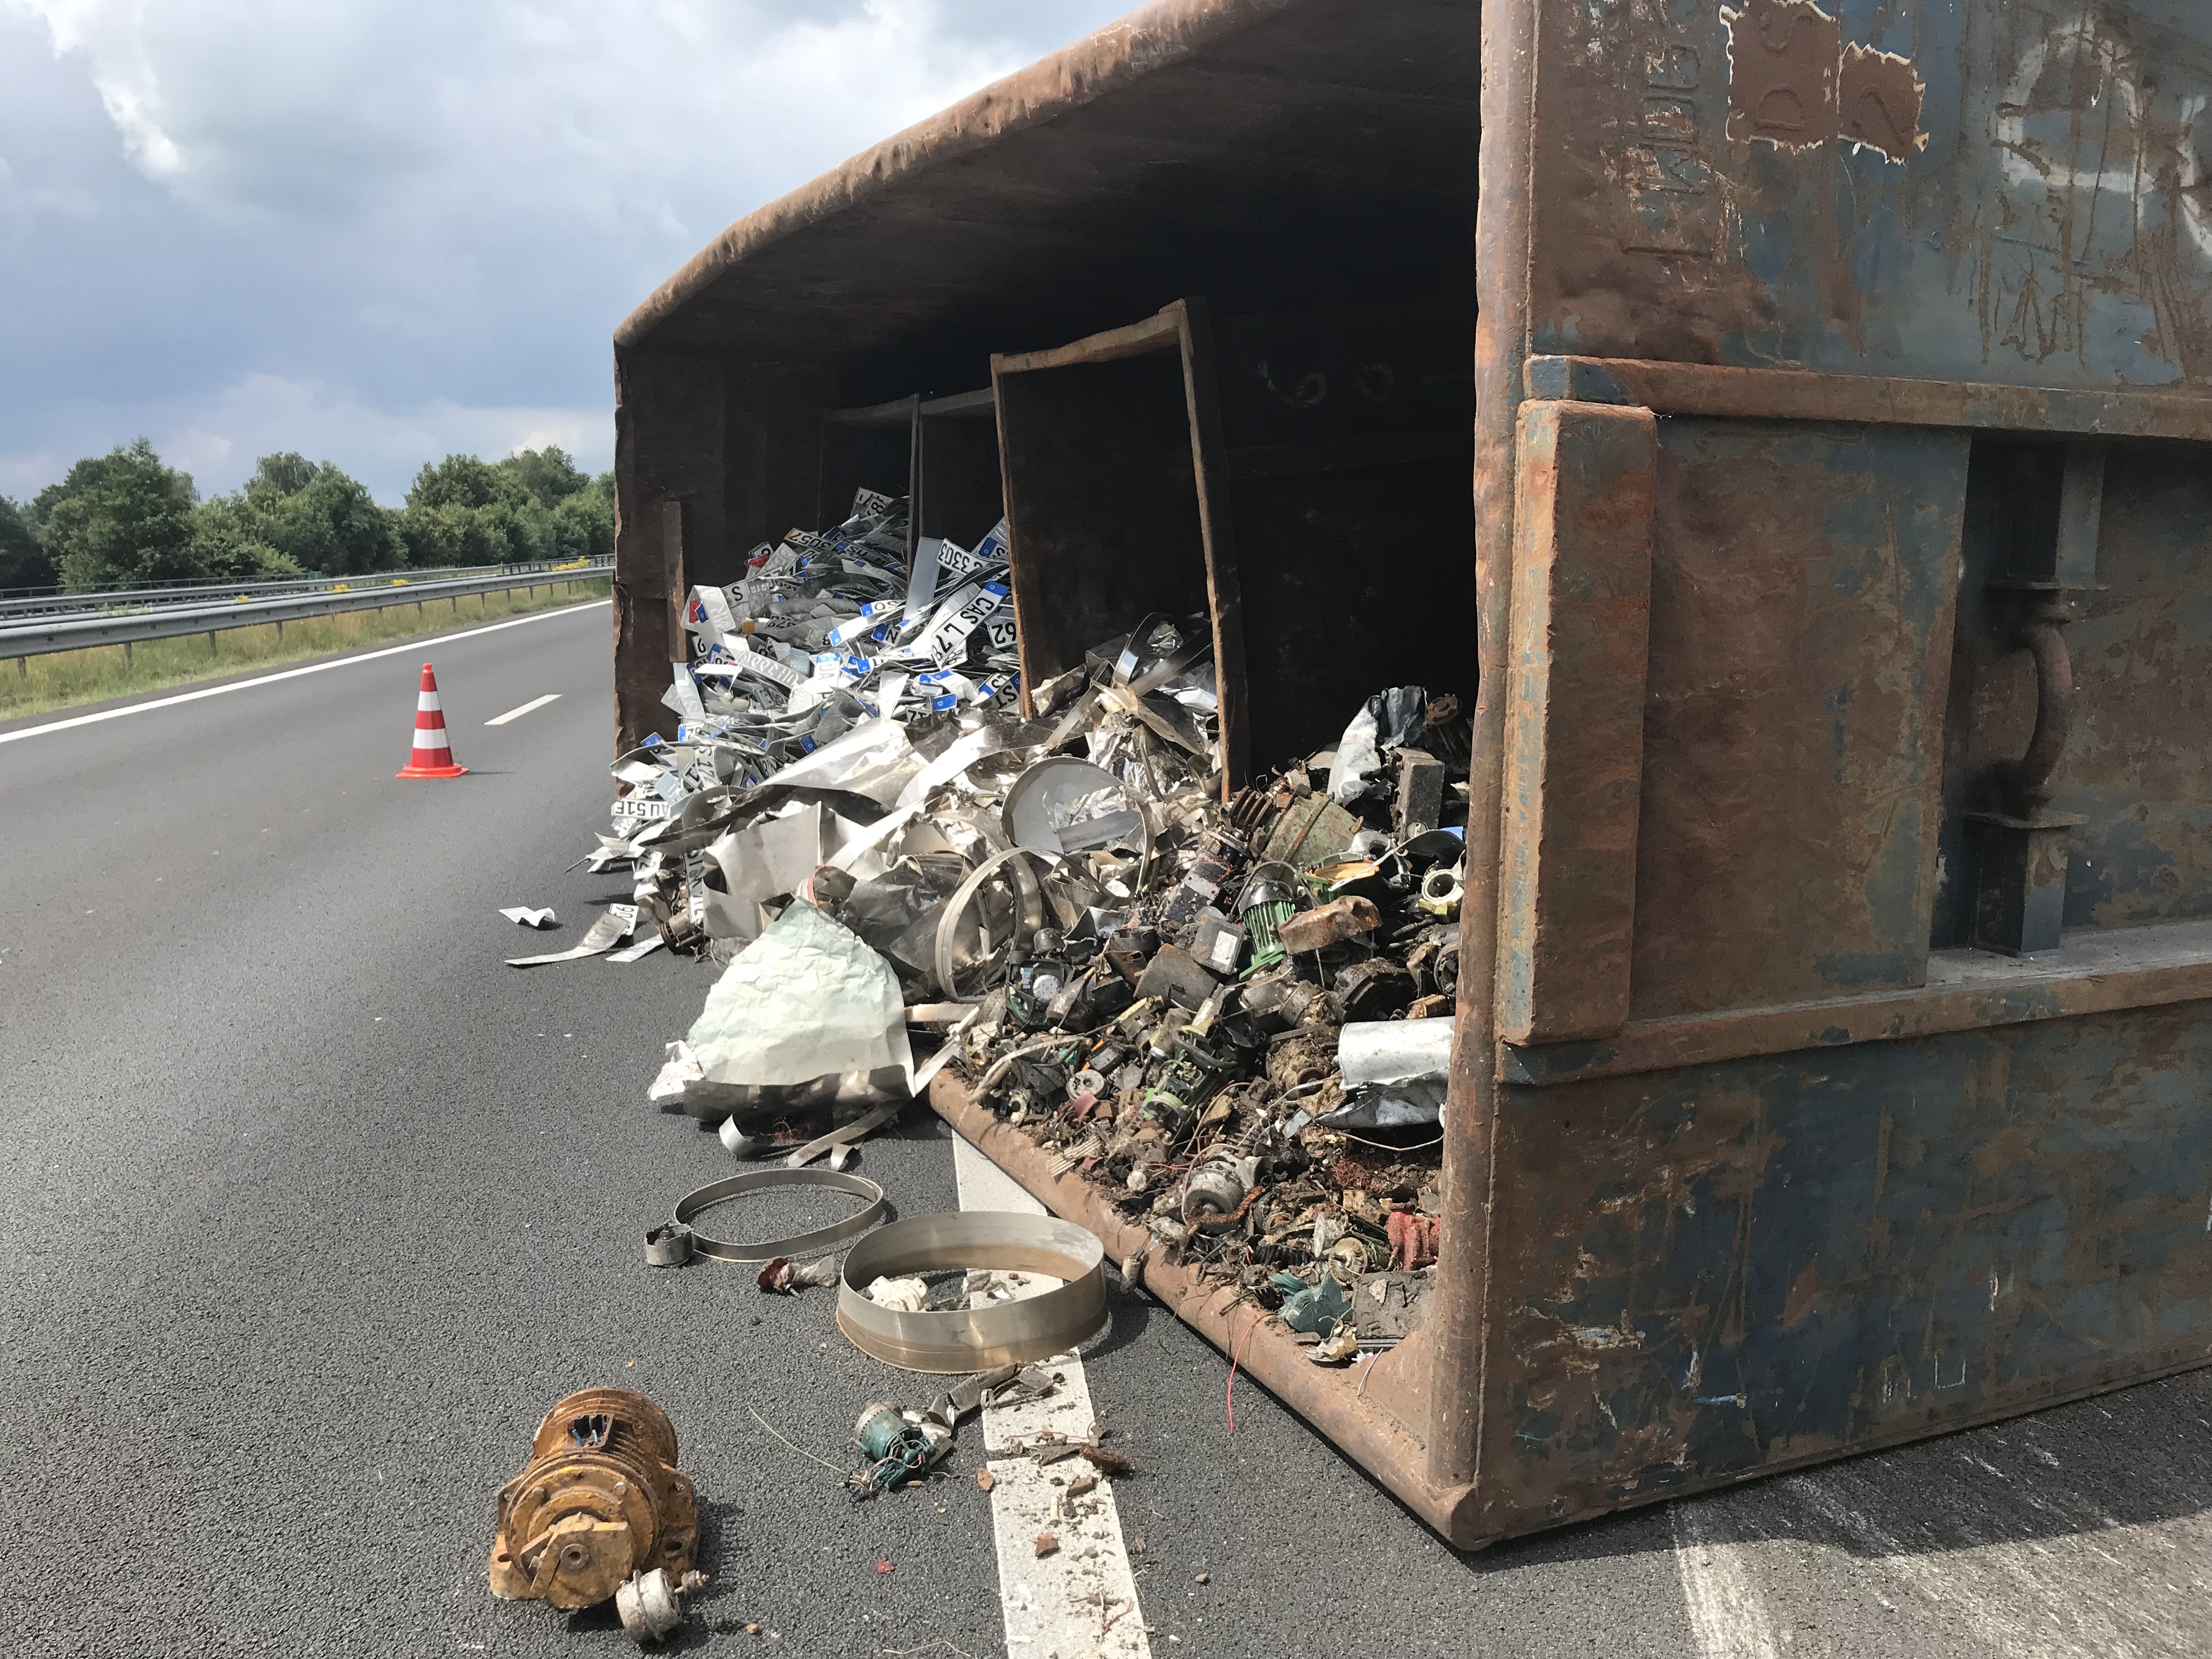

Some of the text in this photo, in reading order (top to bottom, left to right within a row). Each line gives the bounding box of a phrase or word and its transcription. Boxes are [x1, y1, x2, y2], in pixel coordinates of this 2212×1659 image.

[937, 543, 970, 574] 3303
[960, 597, 995, 624] CAS
[944, 622, 965, 635] L
[995, 685, 1018, 709] ST
[614, 800, 646, 817] 51F
